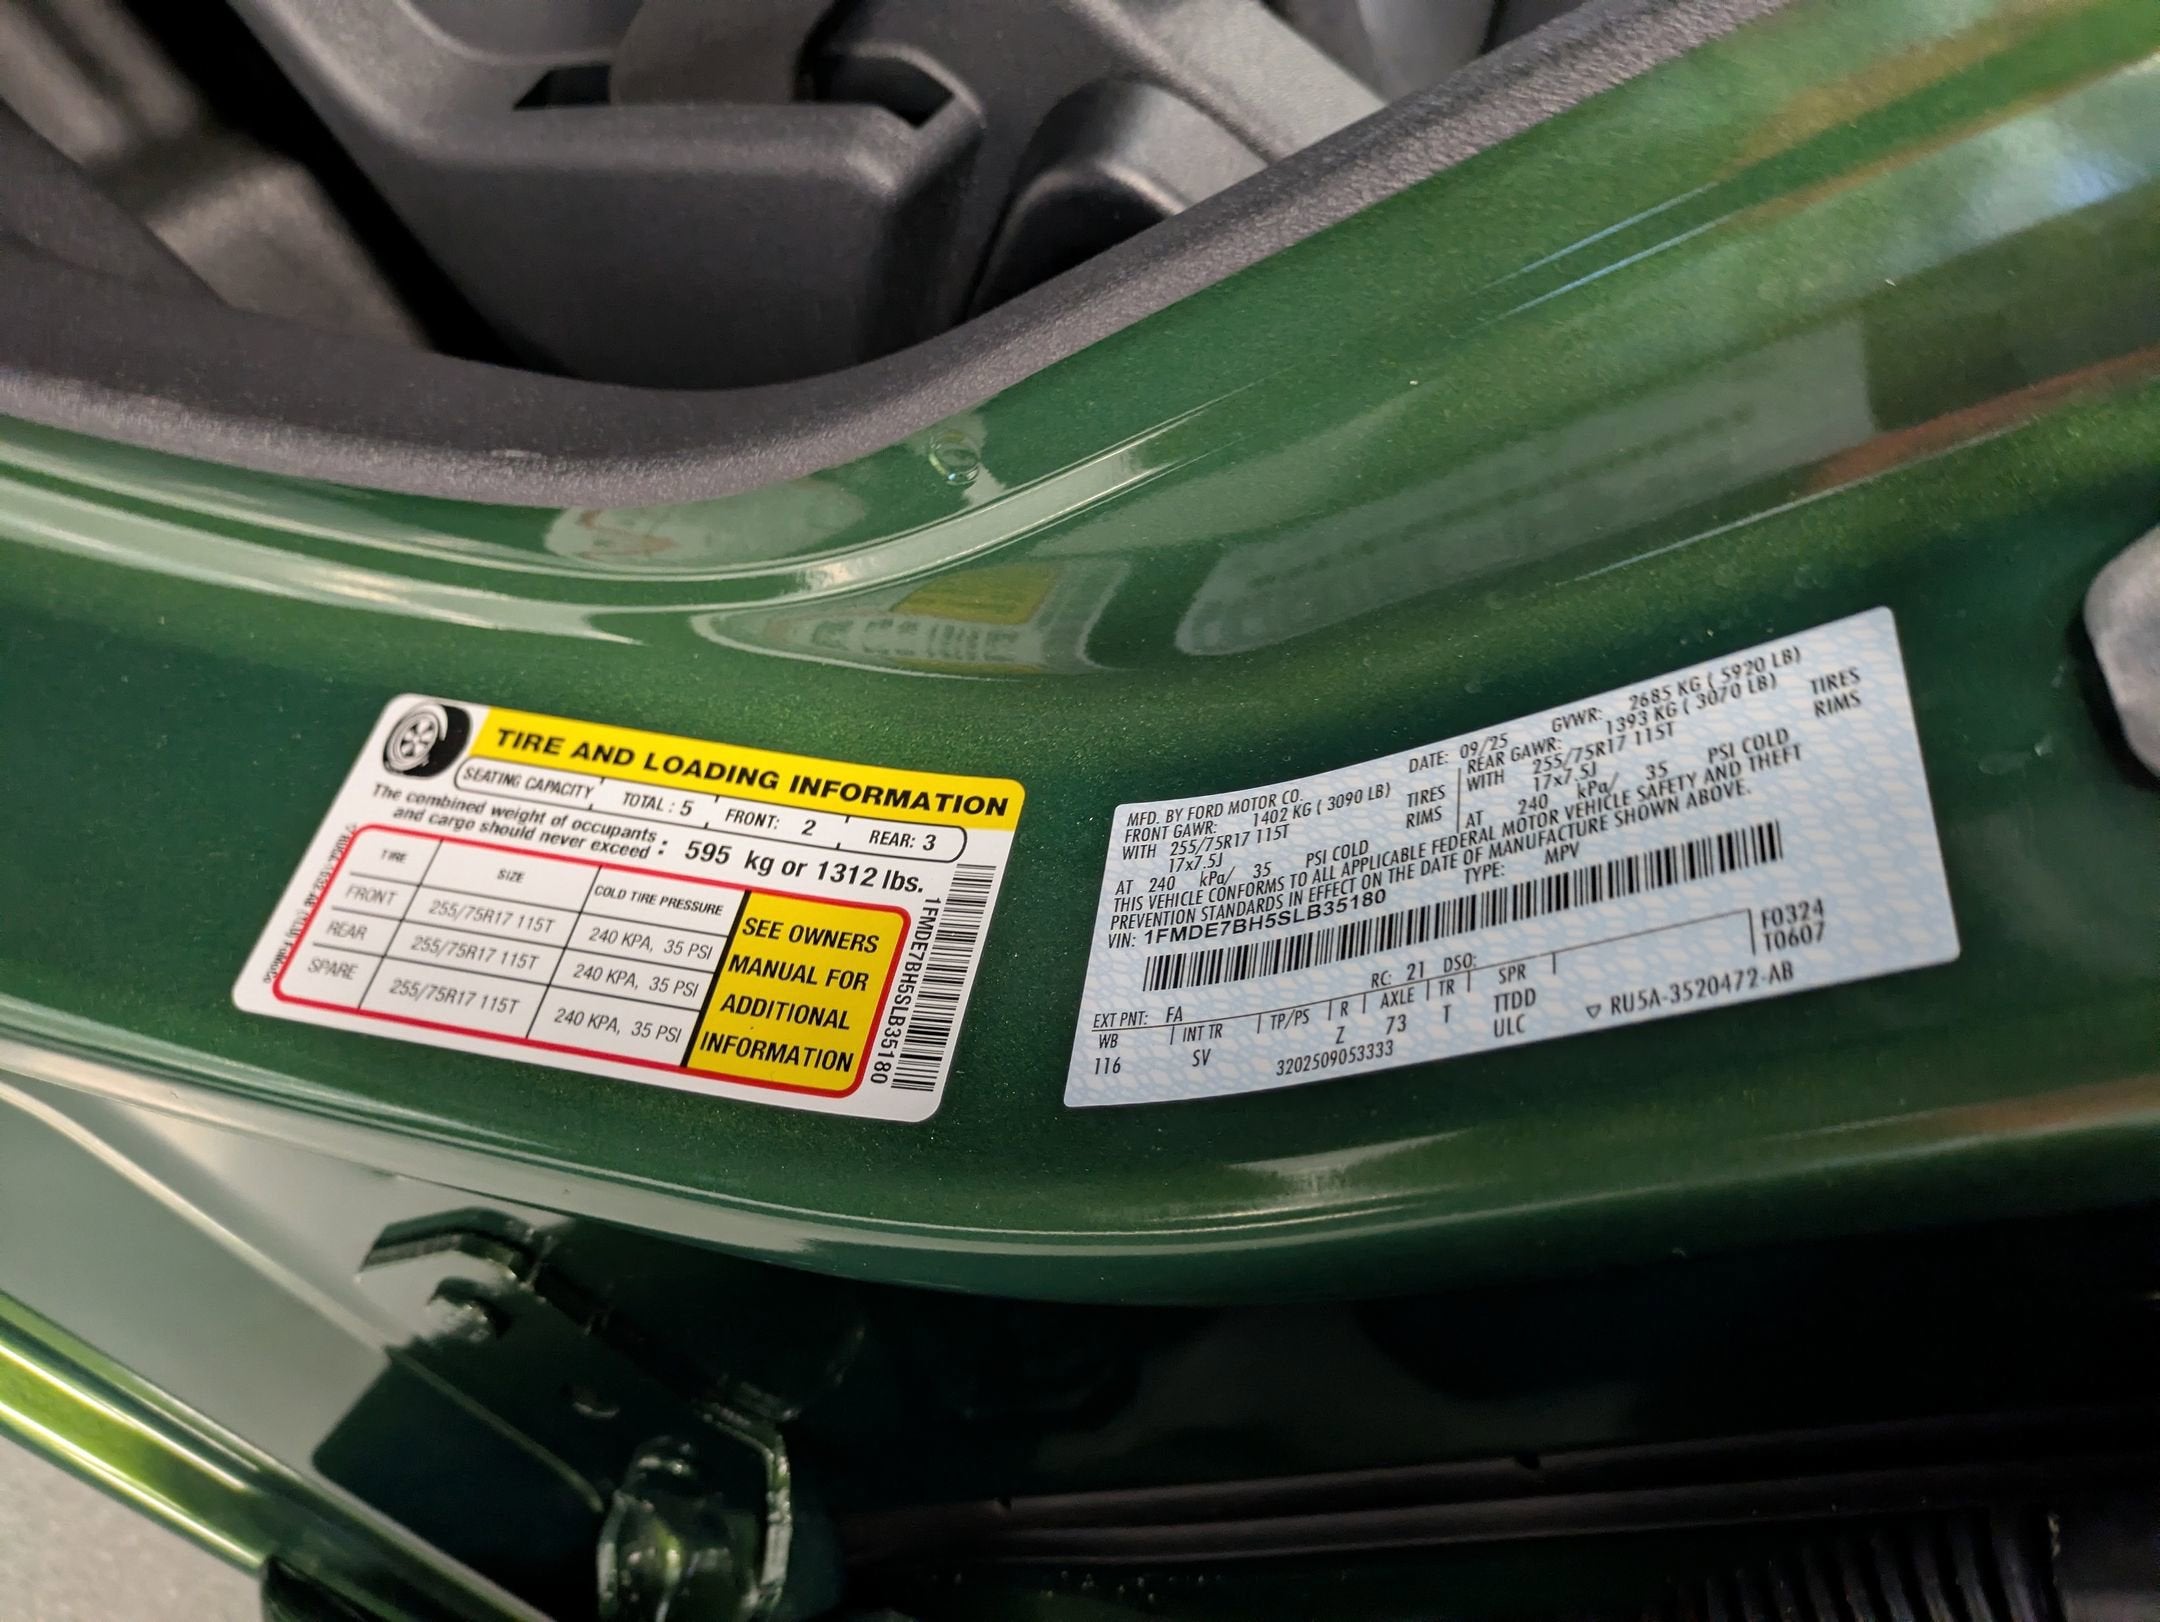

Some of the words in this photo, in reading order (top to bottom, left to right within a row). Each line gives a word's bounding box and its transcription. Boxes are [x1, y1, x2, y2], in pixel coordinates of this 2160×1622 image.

[1552, 707, 1602, 732] GVWR:
[1629, 685, 1671, 710] 2685
[1677, 676, 1700, 695] KG
[1720, 658, 1766, 681] 5920
[1772, 646, 1800, 667] LB)
[1468, 753, 1505, 774] REAR
[1511, 737, 1562, 762] GAWR:
[1606, 710, 1648, 734] 1393
[1654, 701, 1677, 722] KG
[1696, 686, 1742, 710] 3070
[1748, 673, 1777, 694] LB)
[1409, 751, 1449, 773] DATE:
[1460, 733, 1508, 760] 09/25
[464, 767, 521, 787] SEATING
[525, 778, 595, 800] CAPACITY
[498, 729, 564, 755] TIRE
[571, 742, 635, 766] AND
[644, 753, 779, 791] LOADING
[789, 775, 1009, 816] INFORMATION
[1465, 811, 1484, 829] AT
[1518, 794, 1548, 815] 240
[1576, 771, 1620, 799] kPa/
[1645, 760, 1668, 781] 35
[1708, 742, 1734, 764] PSI
[1742, 728, 1789, 754] COLD
[373, 783, 401, 800] The
[406, 791, 485, 814] combined
[492, 804, 546, 824] weight
[551, 815, 568, 827] of
[572, 820, 658, 843] occupants
[679, 800, 695, 816] 5
[725, 809, 780, 830] FRONT:
[802, 820, 817, 836] 2
[1122, 844, 1157, 860] WITH
[1170, 832, 1250, 857] 255/75R17
[1257, 824, 1290, 844] 115T
[1407, 785, 1446, 807] TIRES
[1125, 825, 1169, 843] FRONT
[1173, 821, 1217, 838] GAWR:
[1254, 807, 1288, 827] 1402
[1292, 802, 1311, 819] KG
[1327, 790, 1363, 810] 3090
[1368, 782, 1391, 800] LB)
[1127, 812, 1160, 826] MFD.
[1166, 809, 1183, 821] BY
[1187, 803, 1223, 820] FORD
[1228, 794, 1277, 815] MOTOR
[1282, 789, 1303, 802] CO.
[393, 806, 425, 822] and
[429, 814, 475, 831] cargo
[480, 818, 535, 841] should
[539, 833, 586, 848] never
[591, 841, 651, 859] exceed
[869, 830, 915, 848] REAR:
[923, 834, 936, 851] 3
[1114, 895, 1143, 913] THIS
[1149, 890, 1203, 908] VEHICLE
[1208, 880, 1285, 902] CONFORMS
[1290, 873, 1308, 887] TO
[1312, 866, 1335, 883] ALL
[1341, 842, 1426, 877] APPLICABLE
[1431, 826, 1496, 855] FEDERAL
[1502, 810, 1559, 836] MOTOR
[1565, 790, 1631, 820] VEHICLE
[1637, 772, 1698, 802] SAFETY
[1704, 760, 1741, 785] AND
[1750, 744, 1802, 772] THEFT
[1169, 853, 1223, 873] 17x7.5J
[1406, 806, 1442, 829] RIMS
[381, 850, 407, 864] TIRE
[685, 841, 733, 864] 595
[744, 850, 775, 877] kg
[782, 860, 807, 877] or
[819, 861, 878, 887] 1312
[882, 870, 924, 893] lbs.
[1110, 907, 1195, 930] PREVENTION
[1201, 894, 1284, 921] STANDARDS
[1288, 891, 1303, 905] IN
[1309, 880, 1355, 903] EFFECT
[1361, 869, 1383, 890] ON
[1389, 864, 1415, 884] THE
[1421, 853, 1458, 876] DATE
[1463, 849, 1483, 865] OF
[1488, 815, 1609, 860] MANUFACTURE
[1615, 799, 1680, 828] SHOWN
[1686, 779, 1751, 809] ABOVE.
[1115, 880, 1133, 895] AT
[1148, 876, 1175, 893] 240
[1199, 866, 1235, 887] kPa/
[1253, 862, 1272, 878] 35
[1305, 850, 1326, 868] PSI
[1332, 839, 1369, 862] COLD
[1464, 862, 1505, 884] TYPE:
[1544, 842, 1580, 865] MPV
[497, 869, 525, 884] SIZE
[345, 886, 398, 905] FRONT
[594, 885, 626, 899] COLD
[630, 892, 656, 905] TIRE
[659, 896, 724, 916] PRESSURE
[326, 921, 368, 940] REAR
[429, 900, 513, 926] 255/75R17
[517, 911, 555, 933] 115T
[1109, 933, 1136, 948] VIN:
[1144, 888, 1387, 945] 1FMDE7BH5SLB35180
[1761, 898, 1825, 930] F0324
[589, 928, 618, 944] 240
[621, 933, 653, 952] KPA,
[664, 940, 685, 954] 35
[688, 943, 713, 960] PSI
[742, 918, 784, 940] SEE
[789, 924, 880, 953] OWNERS
[1763, 920, 1826, 952] T0607
[411, 935, 496, 962] 255/75R17
[501, 948, 539, 970] 115T
[307, 958, 358, 981] SPARE
[573, 964, 603, 981] 240
[606, 969, 638, 990] KPA,
[649, 977, 669, 993] 35
[673, 982, 699, 998] PSI
[728, 954, 818, 985] MANUAL
[825, 969, 869, 991] FOR
[1371, 972, 1392, 989] RC:
[1407, 961, 1424, 981] 21
[1499, 964, 1526, 985] SPR
[870, 897, 941, 1084] 1FMDE7BH5SLB35180
[1381, 987, 1415, 1009] AXLE
[1439, 979, 1455, 996] TR
[1494, 988, 1537, 1013] TTDD
[1610, 960, 1794, 1016] RU5A-3520472-AB
[554, 1008, 584, 1025] 240
[588, 1014, 620, 1036] KPA,
[631, 1022, 651, 1038] 35
[655, 1025, 682, 1043] PSI
[720, 994, 850, 1030] ADDITIONAL
[1093, 1013, 1117, 1029] EXT
[1120, 1010, 1148, 1026] PNT:
[1166, 1006, 1183, 1023] FA
[1271, 1009, 1310, 1030] TP/PS
[1386, 1014, 1407, 1035] 73
[1494, 1014, 1526, 1038] ULC
[1099, 1034, 1118, 1049] WB
[1183, 1026, 1204, 1042] INT
[1210, 1024, 1223, 1039] TR
[700, 1031, 854, 1073] INFORMATION
[1095, 1057, 1121, 1075] 116
[1192, 1049, 1211, 1067] SV
[1276, 1039, 1394, 1076] 3202509053333
